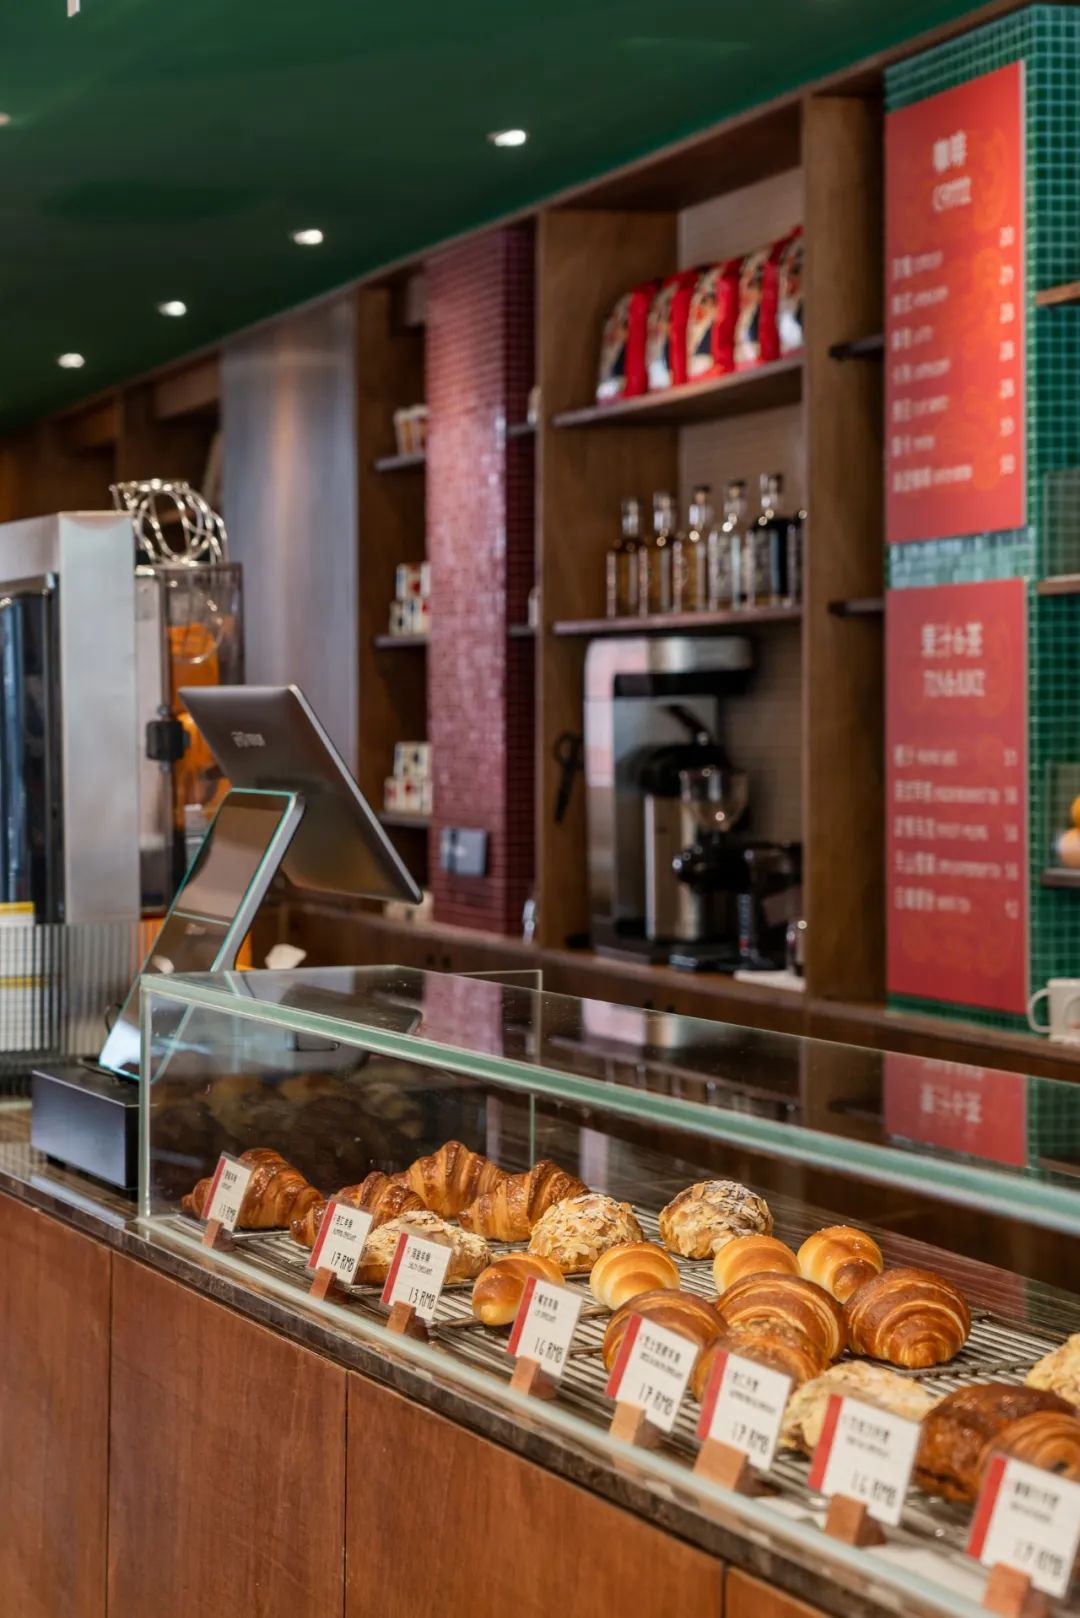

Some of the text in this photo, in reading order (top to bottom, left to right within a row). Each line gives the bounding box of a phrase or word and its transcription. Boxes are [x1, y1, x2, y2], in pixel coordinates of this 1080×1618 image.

[331, 1251, 355, 1273] 17 RMB
[408, 1287, 436, 1310] 13 RMB
[534, 1337, 564, 1363] 16 RMB
[638, 1383, 675, 1416] 17 RMB
[747, 1429, 770, 1455] RMB
[871, 1479, 898, 1509] RMB
[1038, 1550, 1063, 1577] RMB
